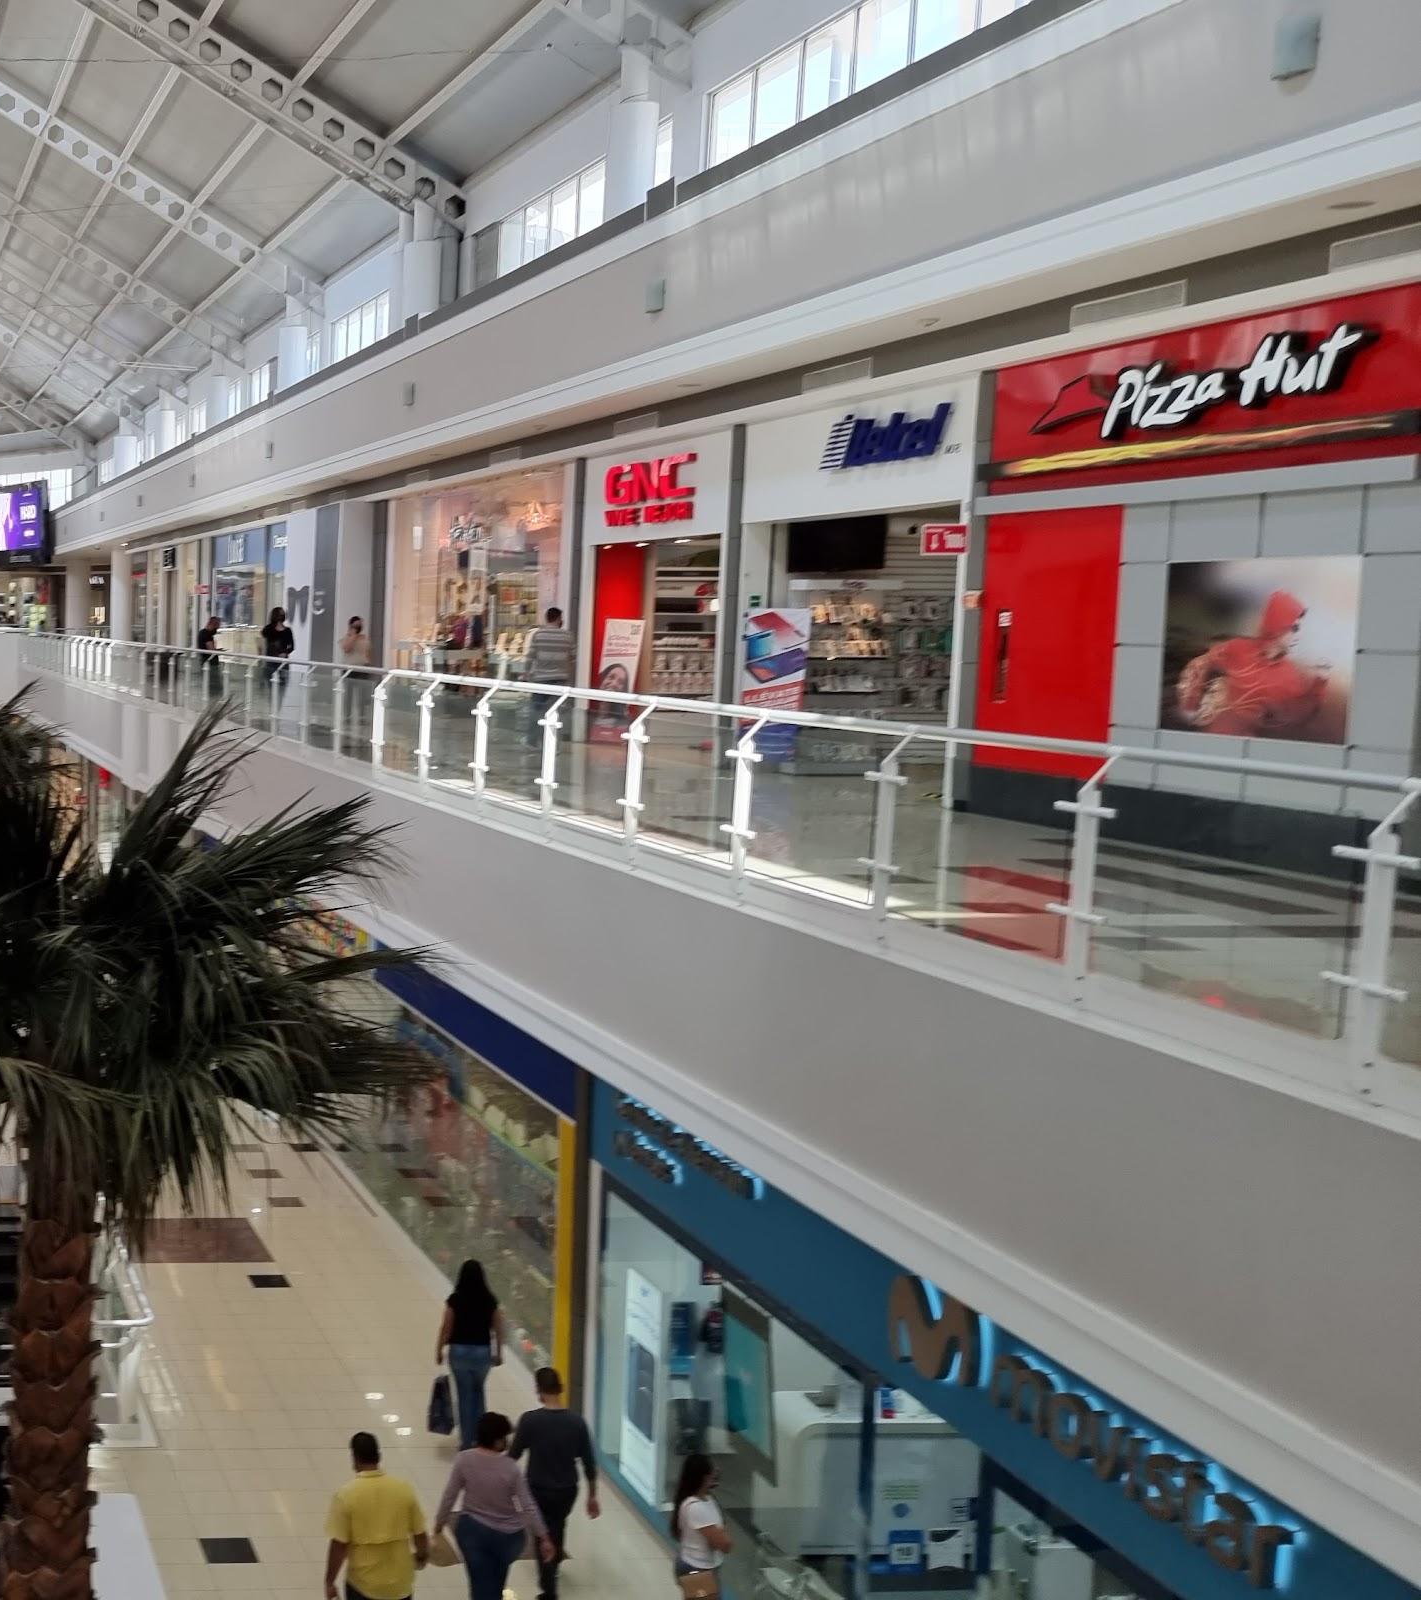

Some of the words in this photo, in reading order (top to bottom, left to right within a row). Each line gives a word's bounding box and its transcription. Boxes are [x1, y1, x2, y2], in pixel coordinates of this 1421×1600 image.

[1101, 364, 1227, 438] Pizza
[1239, 324, 1364, 406] Hut
[605, 453, 697, 506] GNC
[991, 1353, 1294, 1589] movistar
